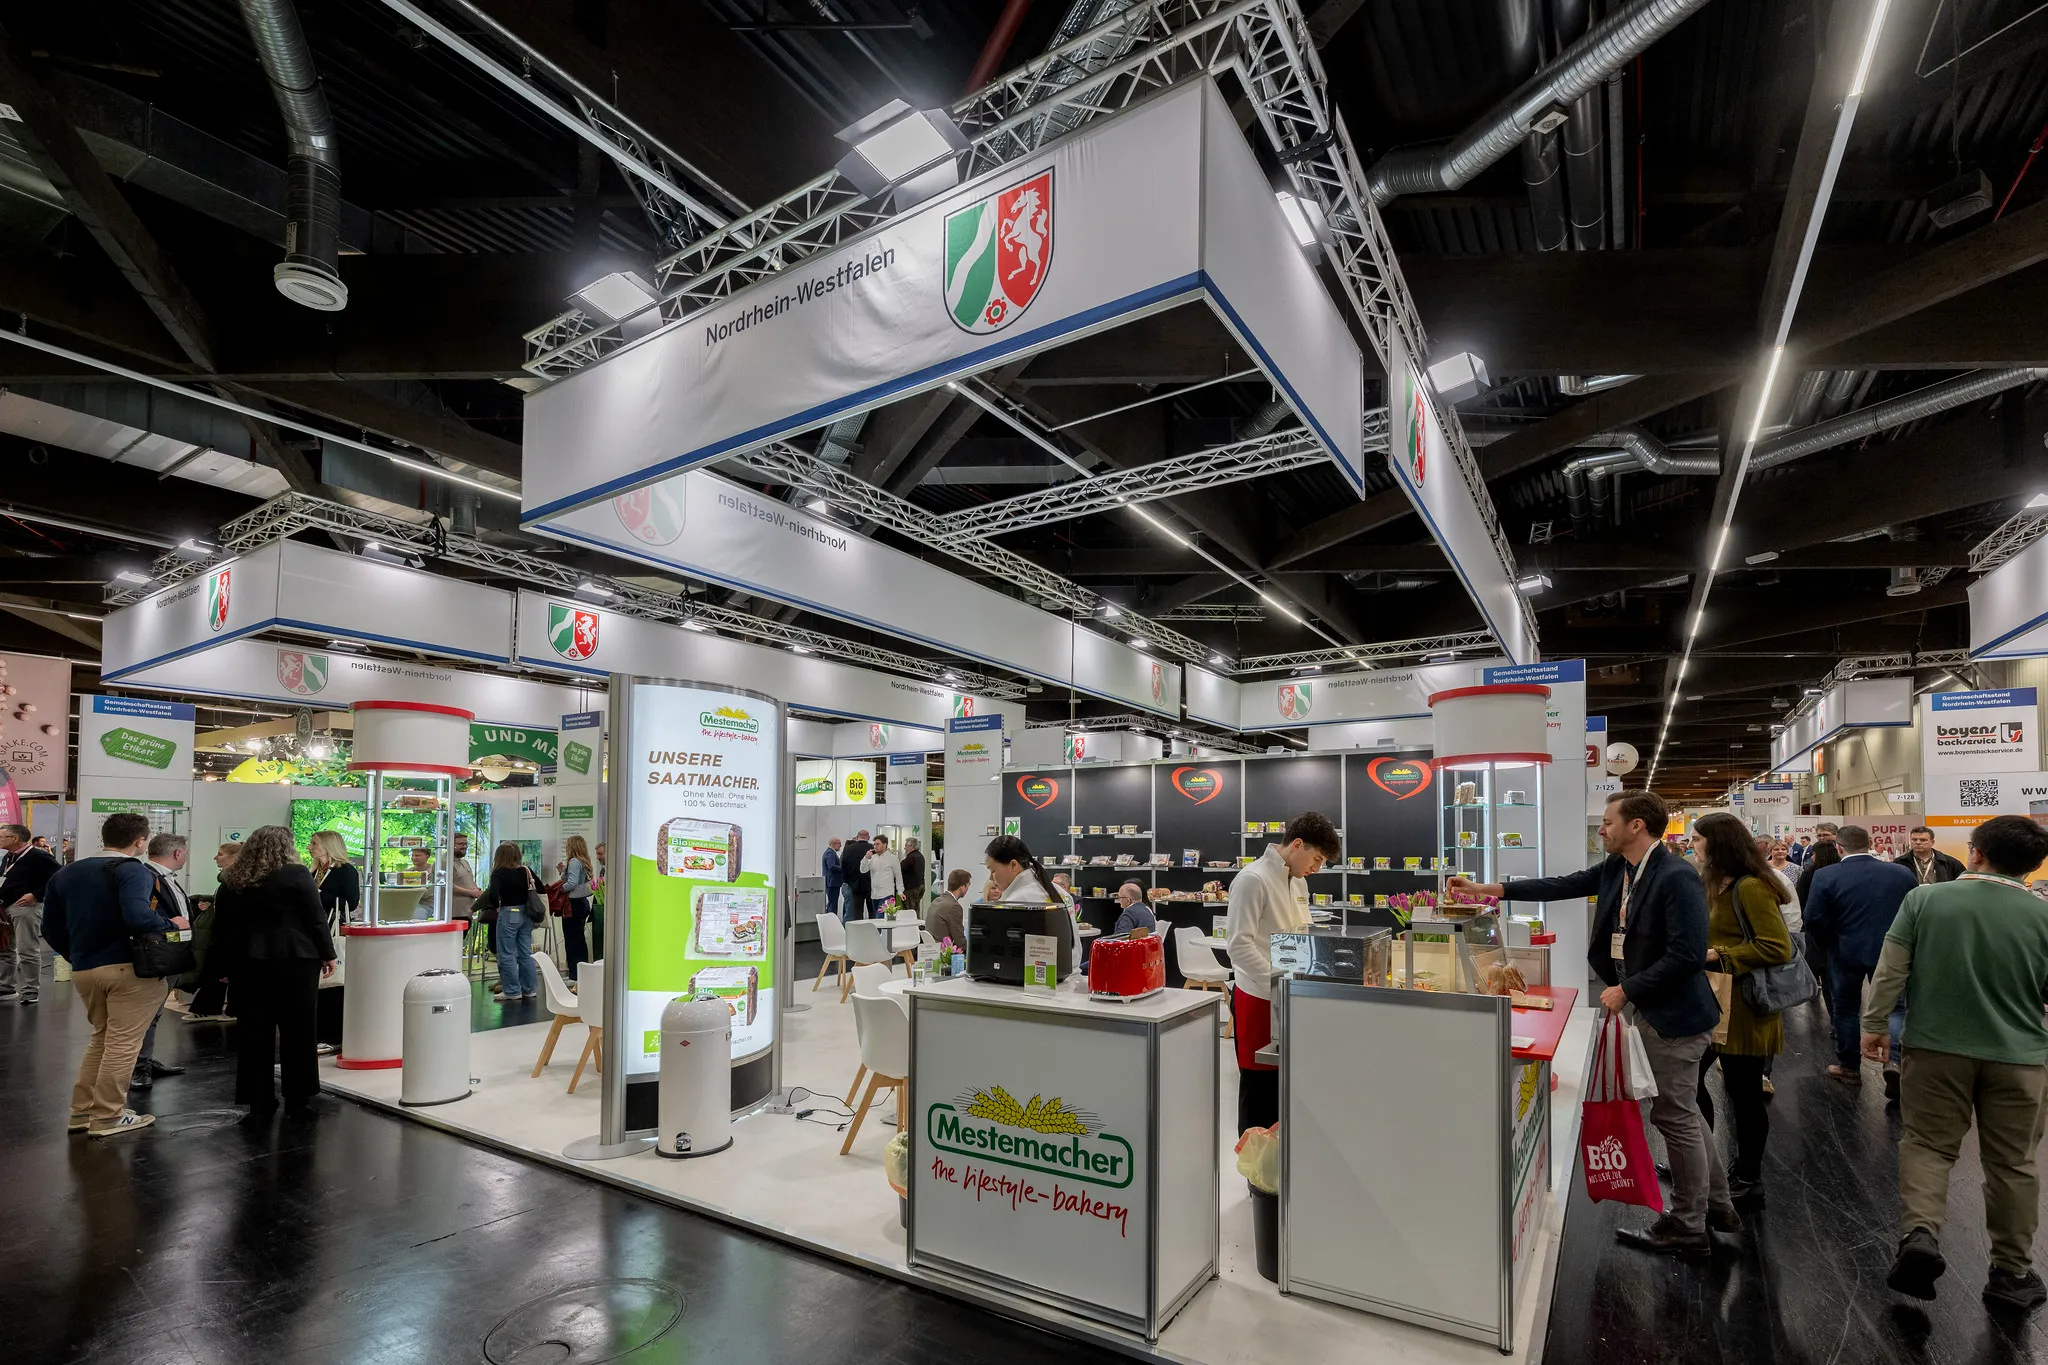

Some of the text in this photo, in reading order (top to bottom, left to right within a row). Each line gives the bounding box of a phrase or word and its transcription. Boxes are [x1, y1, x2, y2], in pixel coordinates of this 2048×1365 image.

[706, 248, 895, 346] Nordrhein-Westfalen
[156, 584, 200, 609] Nordrhein-Westfalen
[1493, 665, 1558, 676] Gemeinschaftsstand
[1493, 674, 1559, 684] Nordrhein-Westfalen
[891, 681, 945, 698] Nordrhein-Westfalen
[1942, 692, 2010, 701] Gemeinschaftsstand
[104, 699, 171, 710] Gemeinschaftsstand
[1942, 699, 2011, 708] Nordrhein-Westfalen
[104, 705, 171, 716] Nordrhein-Westfalen
[703, 715, 756, 730] Mestemacher
[484, 729, 527, 744] UND
[701, 728, 712, 737] the
[1937, 725, 1996, 738] boyens
[121, 732, 166, 750] Das grüne
[1937, 737, 1996, 746] backservice
[122, 742, 156, 756] Etikett
[1938, 747, 2023, 757] www.boyensbackservice.de
[648, 751, 723, 767] UNSERE
[21, 761, 46, 775] SHOP
[647, 771, 760, 790] SAATMACHER.
[683, 790, 704, 798] Ohne
[728, 792, 744, 800] Ohne
[683, 800, 698, 808] 100
[700, 800, 706, 808] %
[337, 821, 353, 832] Das
[1871, 825, 1906, 834] PURE
[671, 837, 688, 846] Bio
[936, 1113, 1123, 1176] Mestemacher
[932, 1156, 957, 1183] the
